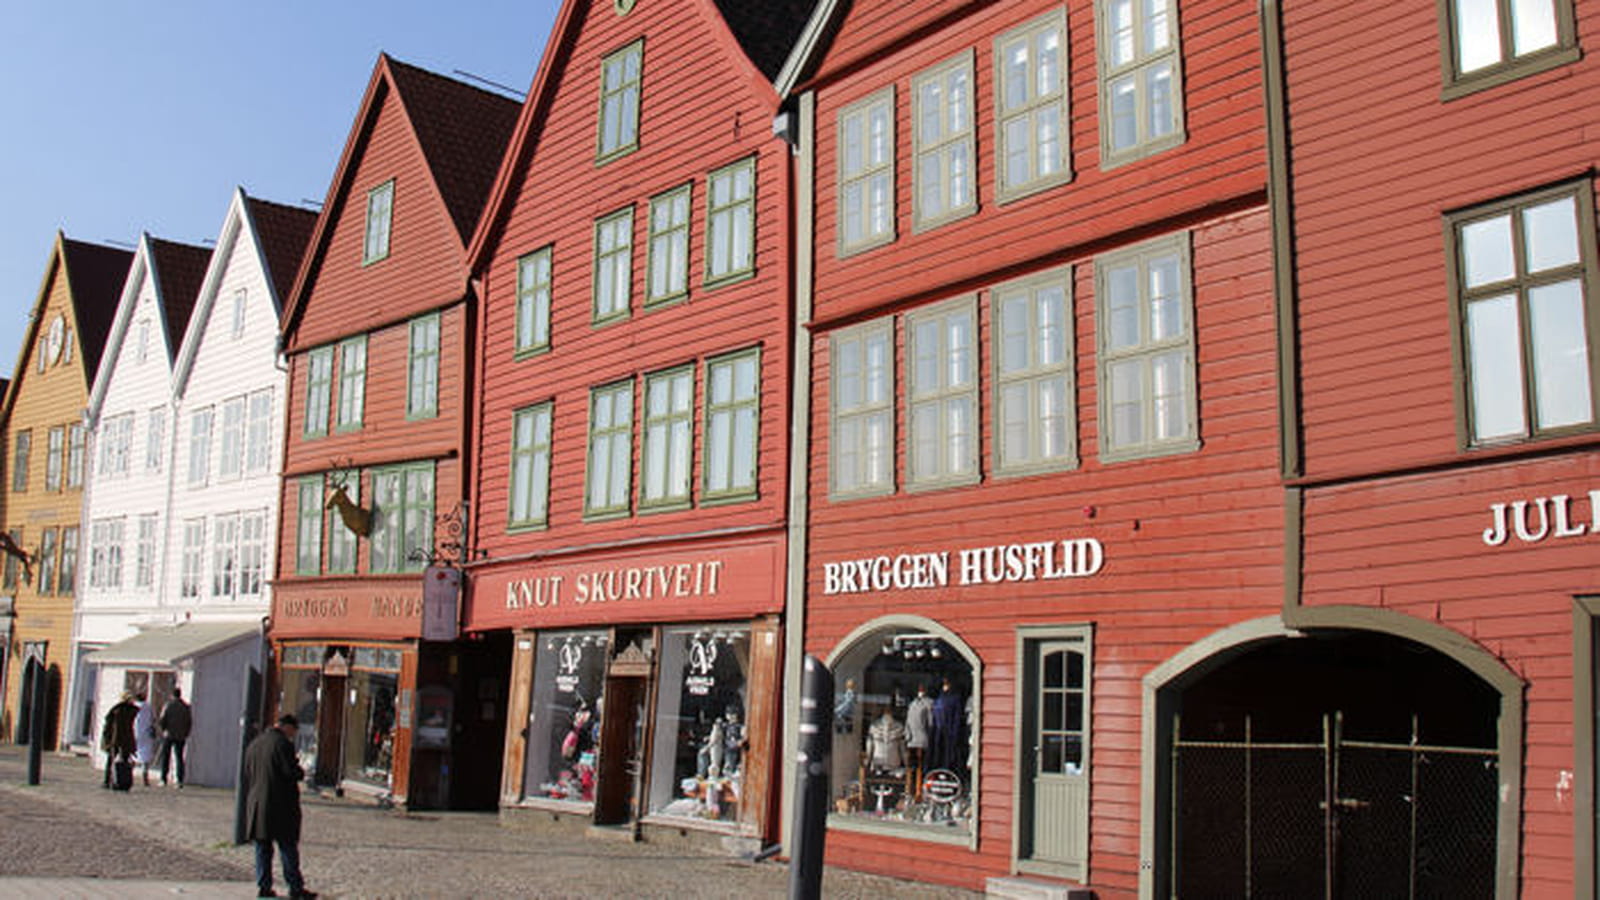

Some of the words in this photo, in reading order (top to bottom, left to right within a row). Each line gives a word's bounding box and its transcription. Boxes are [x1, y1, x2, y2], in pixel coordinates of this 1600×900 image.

[506, 576, 562, 609] KNUT
[575, 561, 722, 604] SKURTVEIT
[823, 551, 950, 595] BRYGGEN
[959, 537, 1104, 586] HUSFLID
